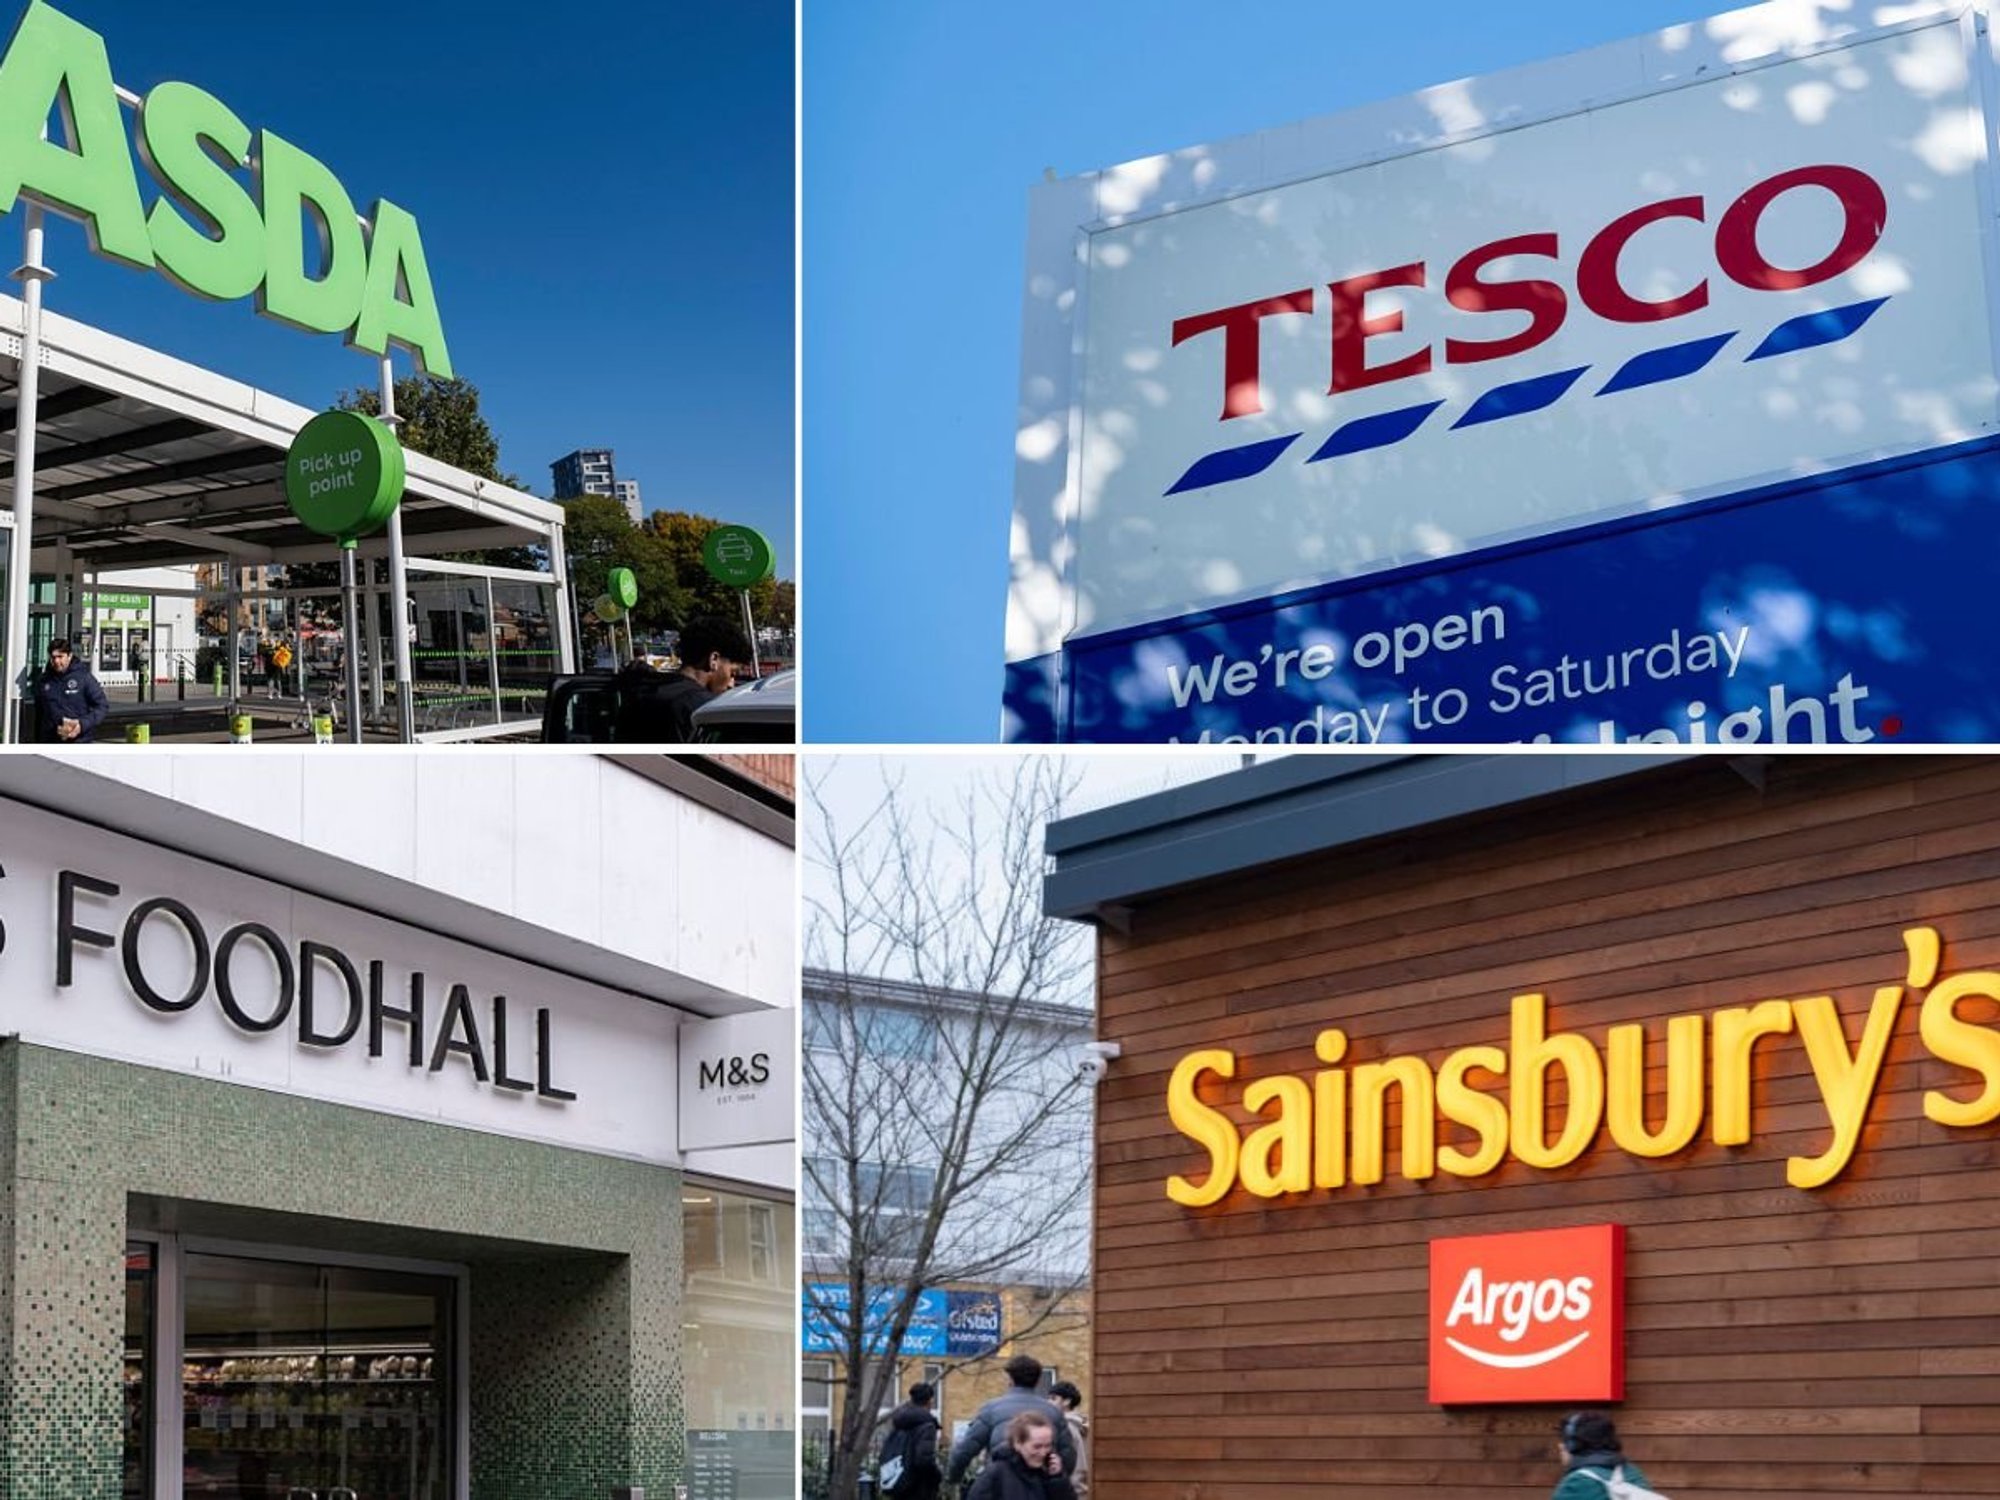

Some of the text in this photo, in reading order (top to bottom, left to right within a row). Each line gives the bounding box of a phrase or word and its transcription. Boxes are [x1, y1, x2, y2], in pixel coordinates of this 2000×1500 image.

[0, 0, 453, 381] ASDA
[1172, 164, 1887, 422] TESCO
[300, 449, 362, 475] Pick up
[309, 470, 355, 498] point
[1168, 626, 1749, 743] nday to Saturday
[1353, 605, 1505, 674] open
[56, 869, 577, 1101] FOODHALL
[699, 1053, 769, 1089] M&S
[1166, 926, 2000, 1208] Sainsbury's
[1446, 1267, 1593, 1342] Argos
